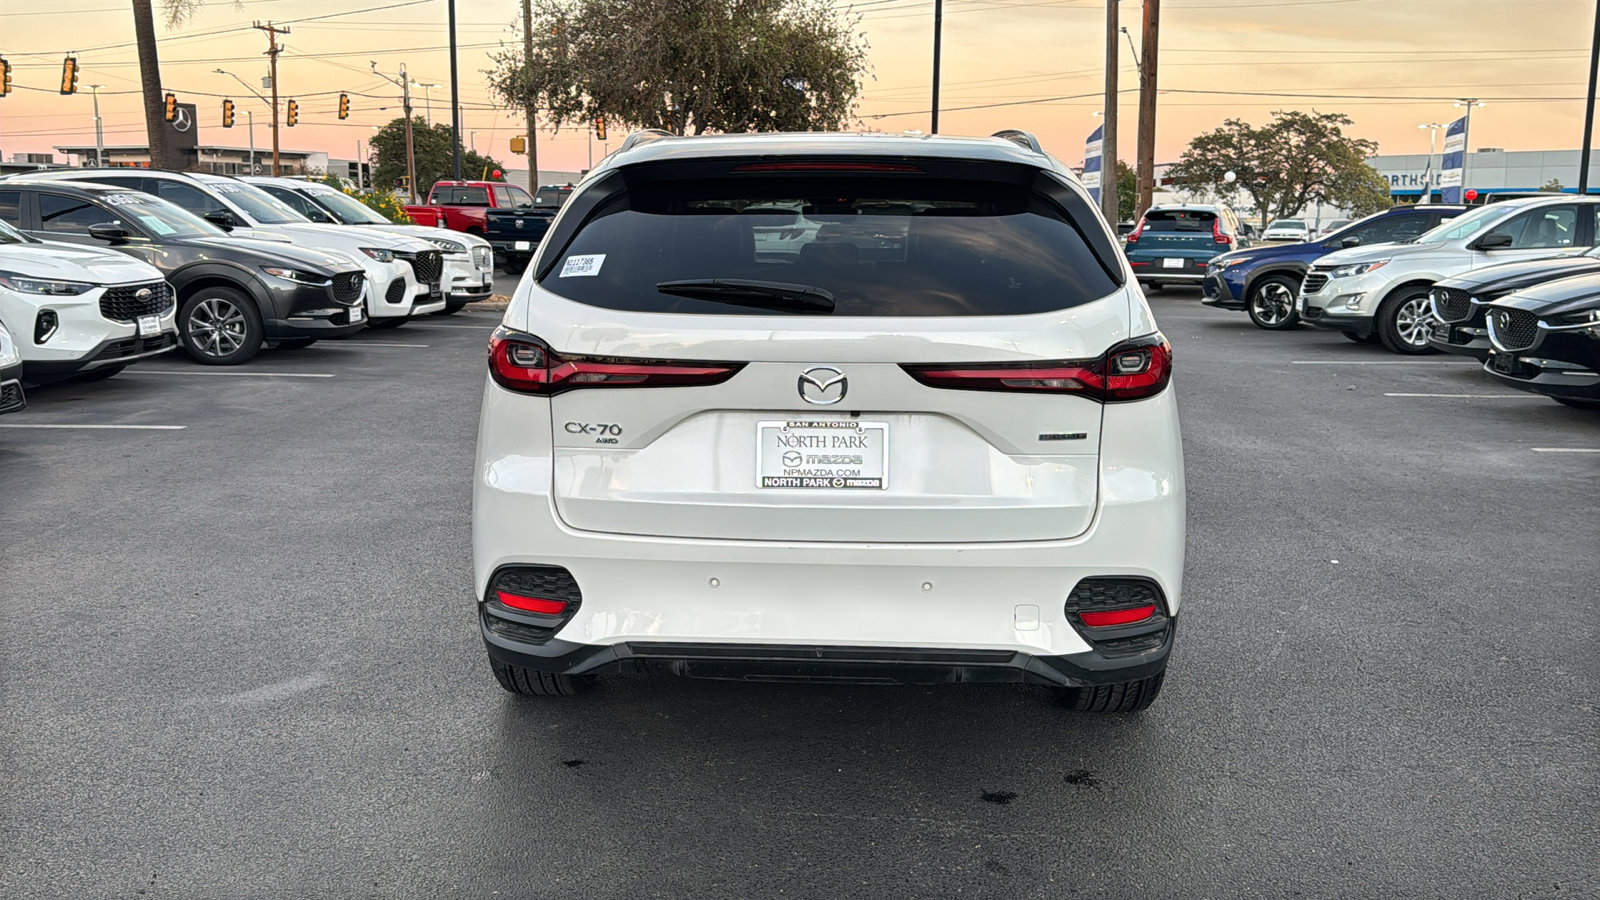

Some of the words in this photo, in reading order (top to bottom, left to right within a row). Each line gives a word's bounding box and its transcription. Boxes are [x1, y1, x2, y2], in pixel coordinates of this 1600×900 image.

[564, 421, 623, 436] CX-70
[776, 435, 826, 448] NORTH
[832, 436, 868, 448] PARK
[806, 454, 863, 465] mazda
[783, 469, 861, 477] NPMAZDA.COM
[764, 478, 801, 487] NORTH
[802, 478, 831, 487] PARK
[846, 479, 880, 487] mazda
